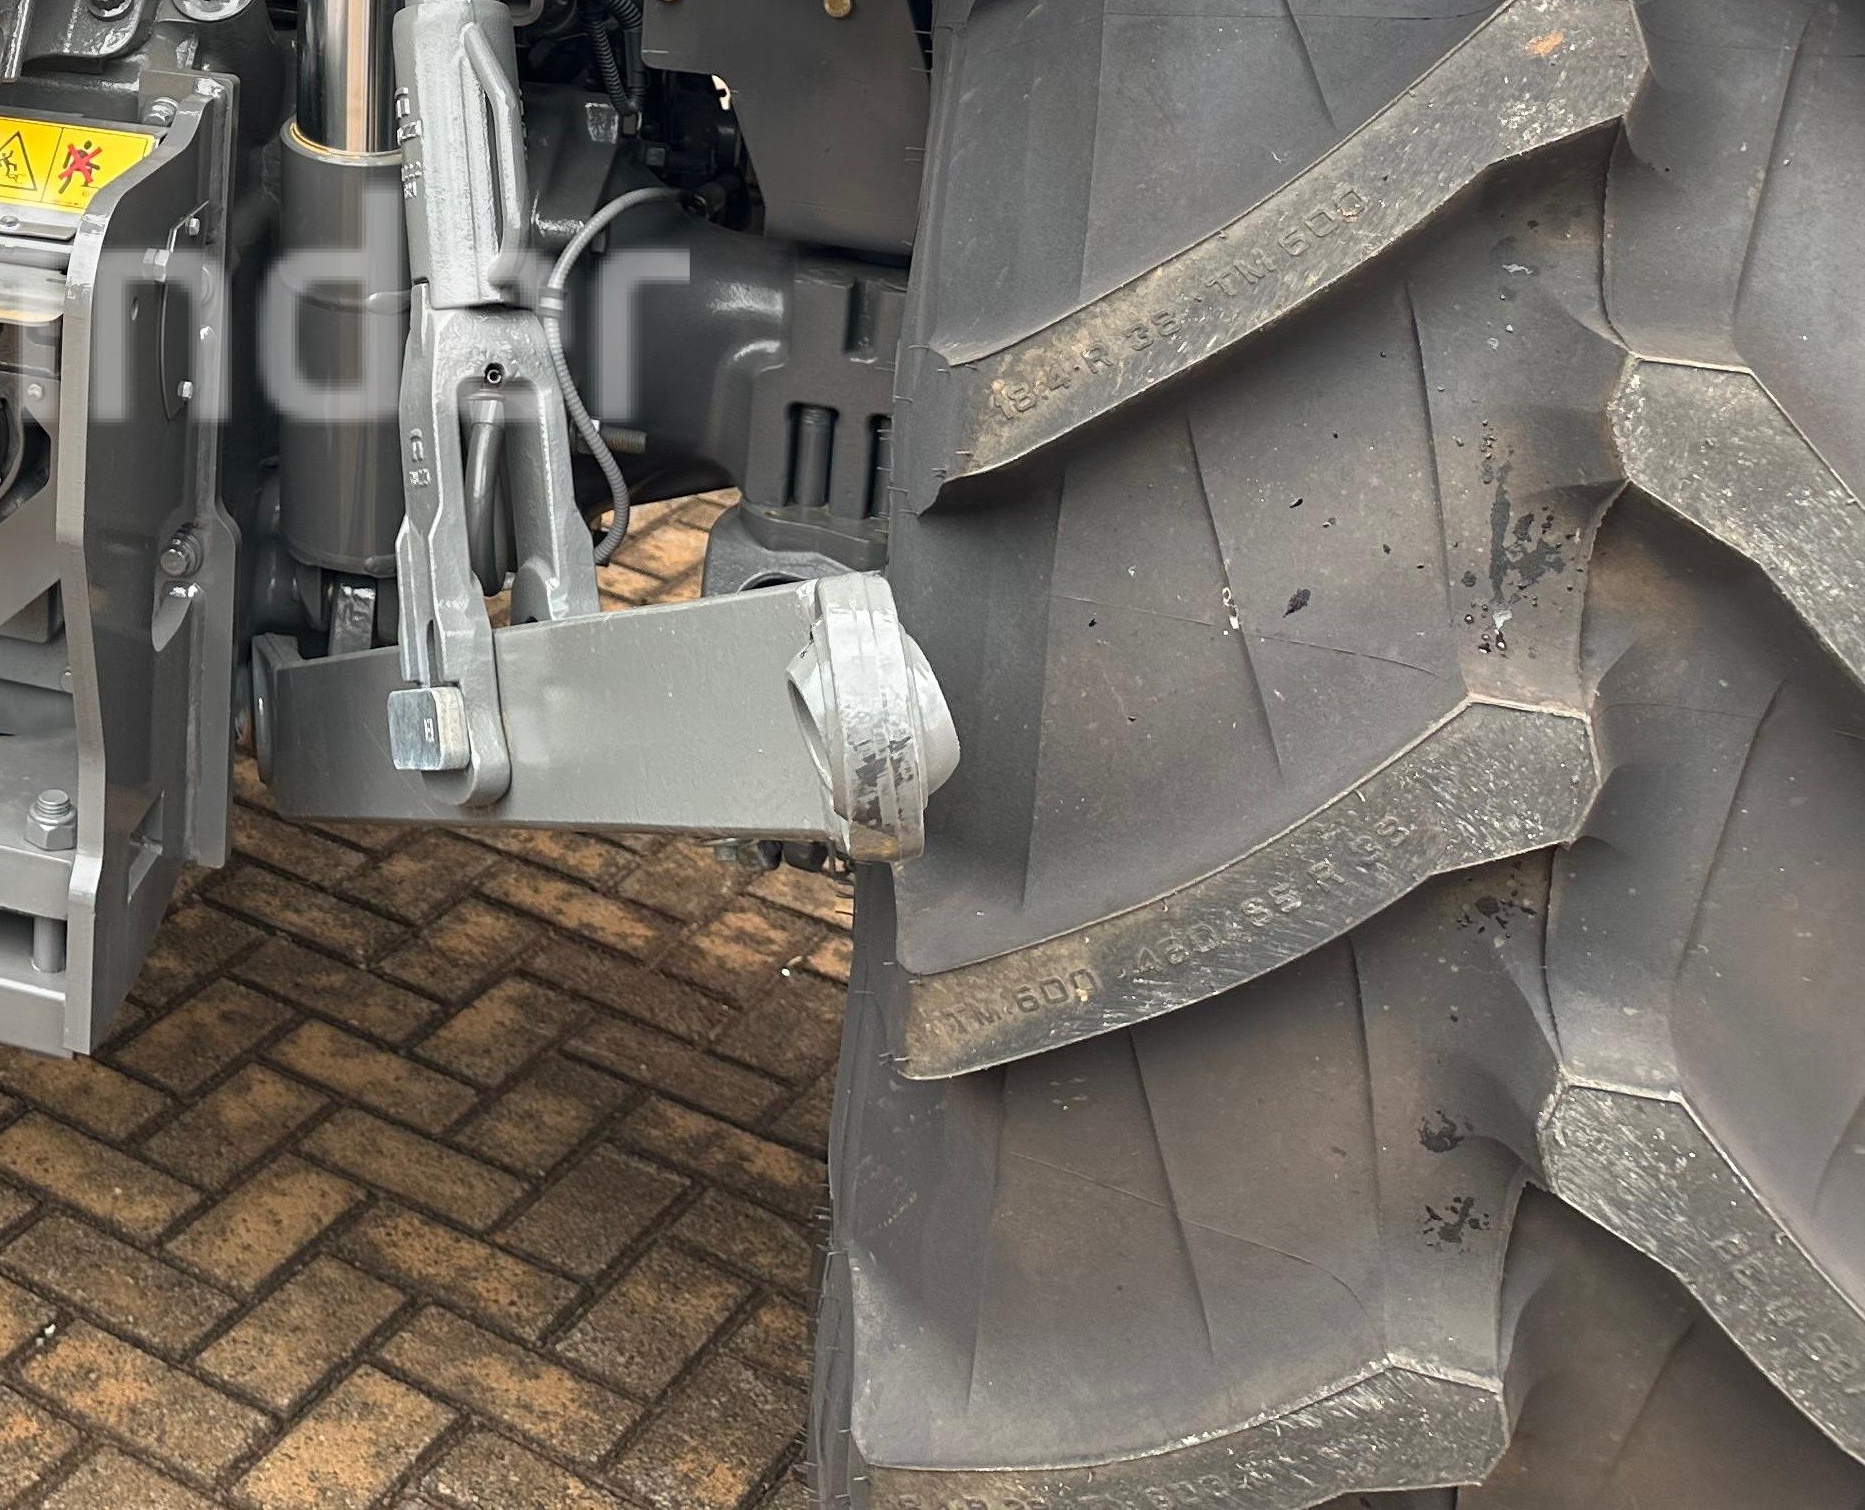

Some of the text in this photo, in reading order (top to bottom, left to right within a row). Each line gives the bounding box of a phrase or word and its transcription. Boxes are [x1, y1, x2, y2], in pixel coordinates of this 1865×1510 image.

[1126, 308, 1183, 352] 38
[1206, 246, 1278, 298] TM
[1277, 188, 1367, 258] 600
